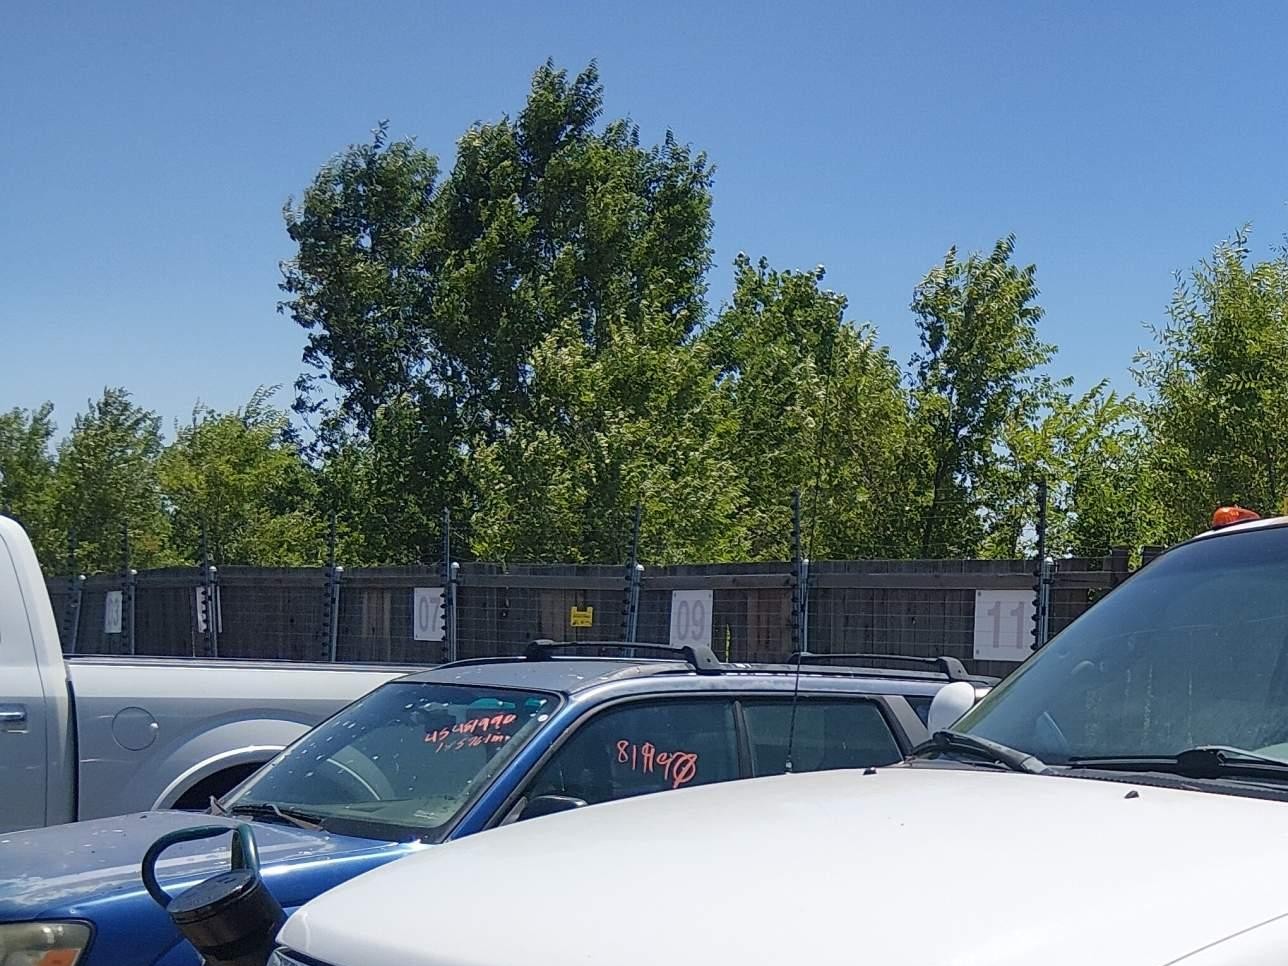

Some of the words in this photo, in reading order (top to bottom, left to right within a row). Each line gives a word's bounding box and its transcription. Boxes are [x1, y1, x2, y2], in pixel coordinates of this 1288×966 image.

[418, 596, 443, 632] 07
[678, 600, 705, 640] 09
[987, 601, 1025, 649] 11
